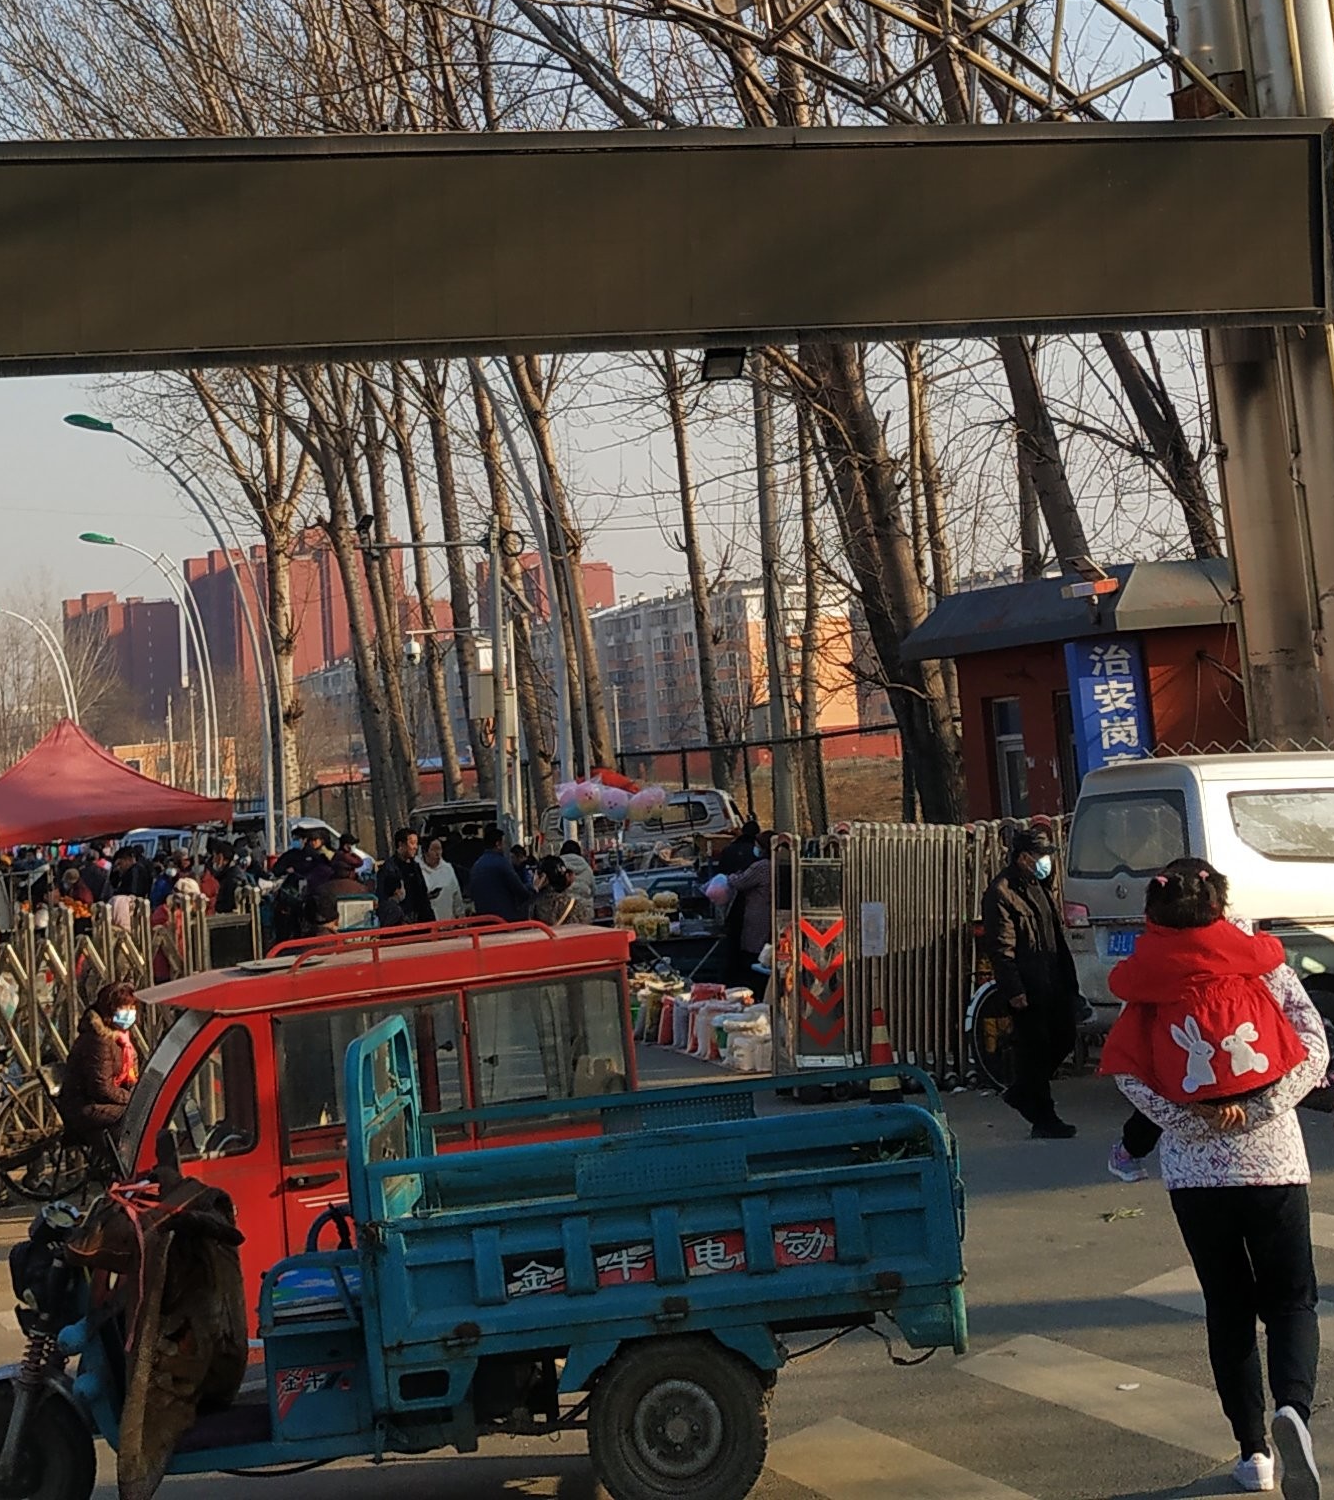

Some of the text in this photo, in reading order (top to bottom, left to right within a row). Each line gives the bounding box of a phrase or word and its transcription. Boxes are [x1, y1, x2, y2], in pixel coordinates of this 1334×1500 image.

[512, 1226, 827, 1292] 金牛电动
[281, 1370, 325, 1393] 金牛
